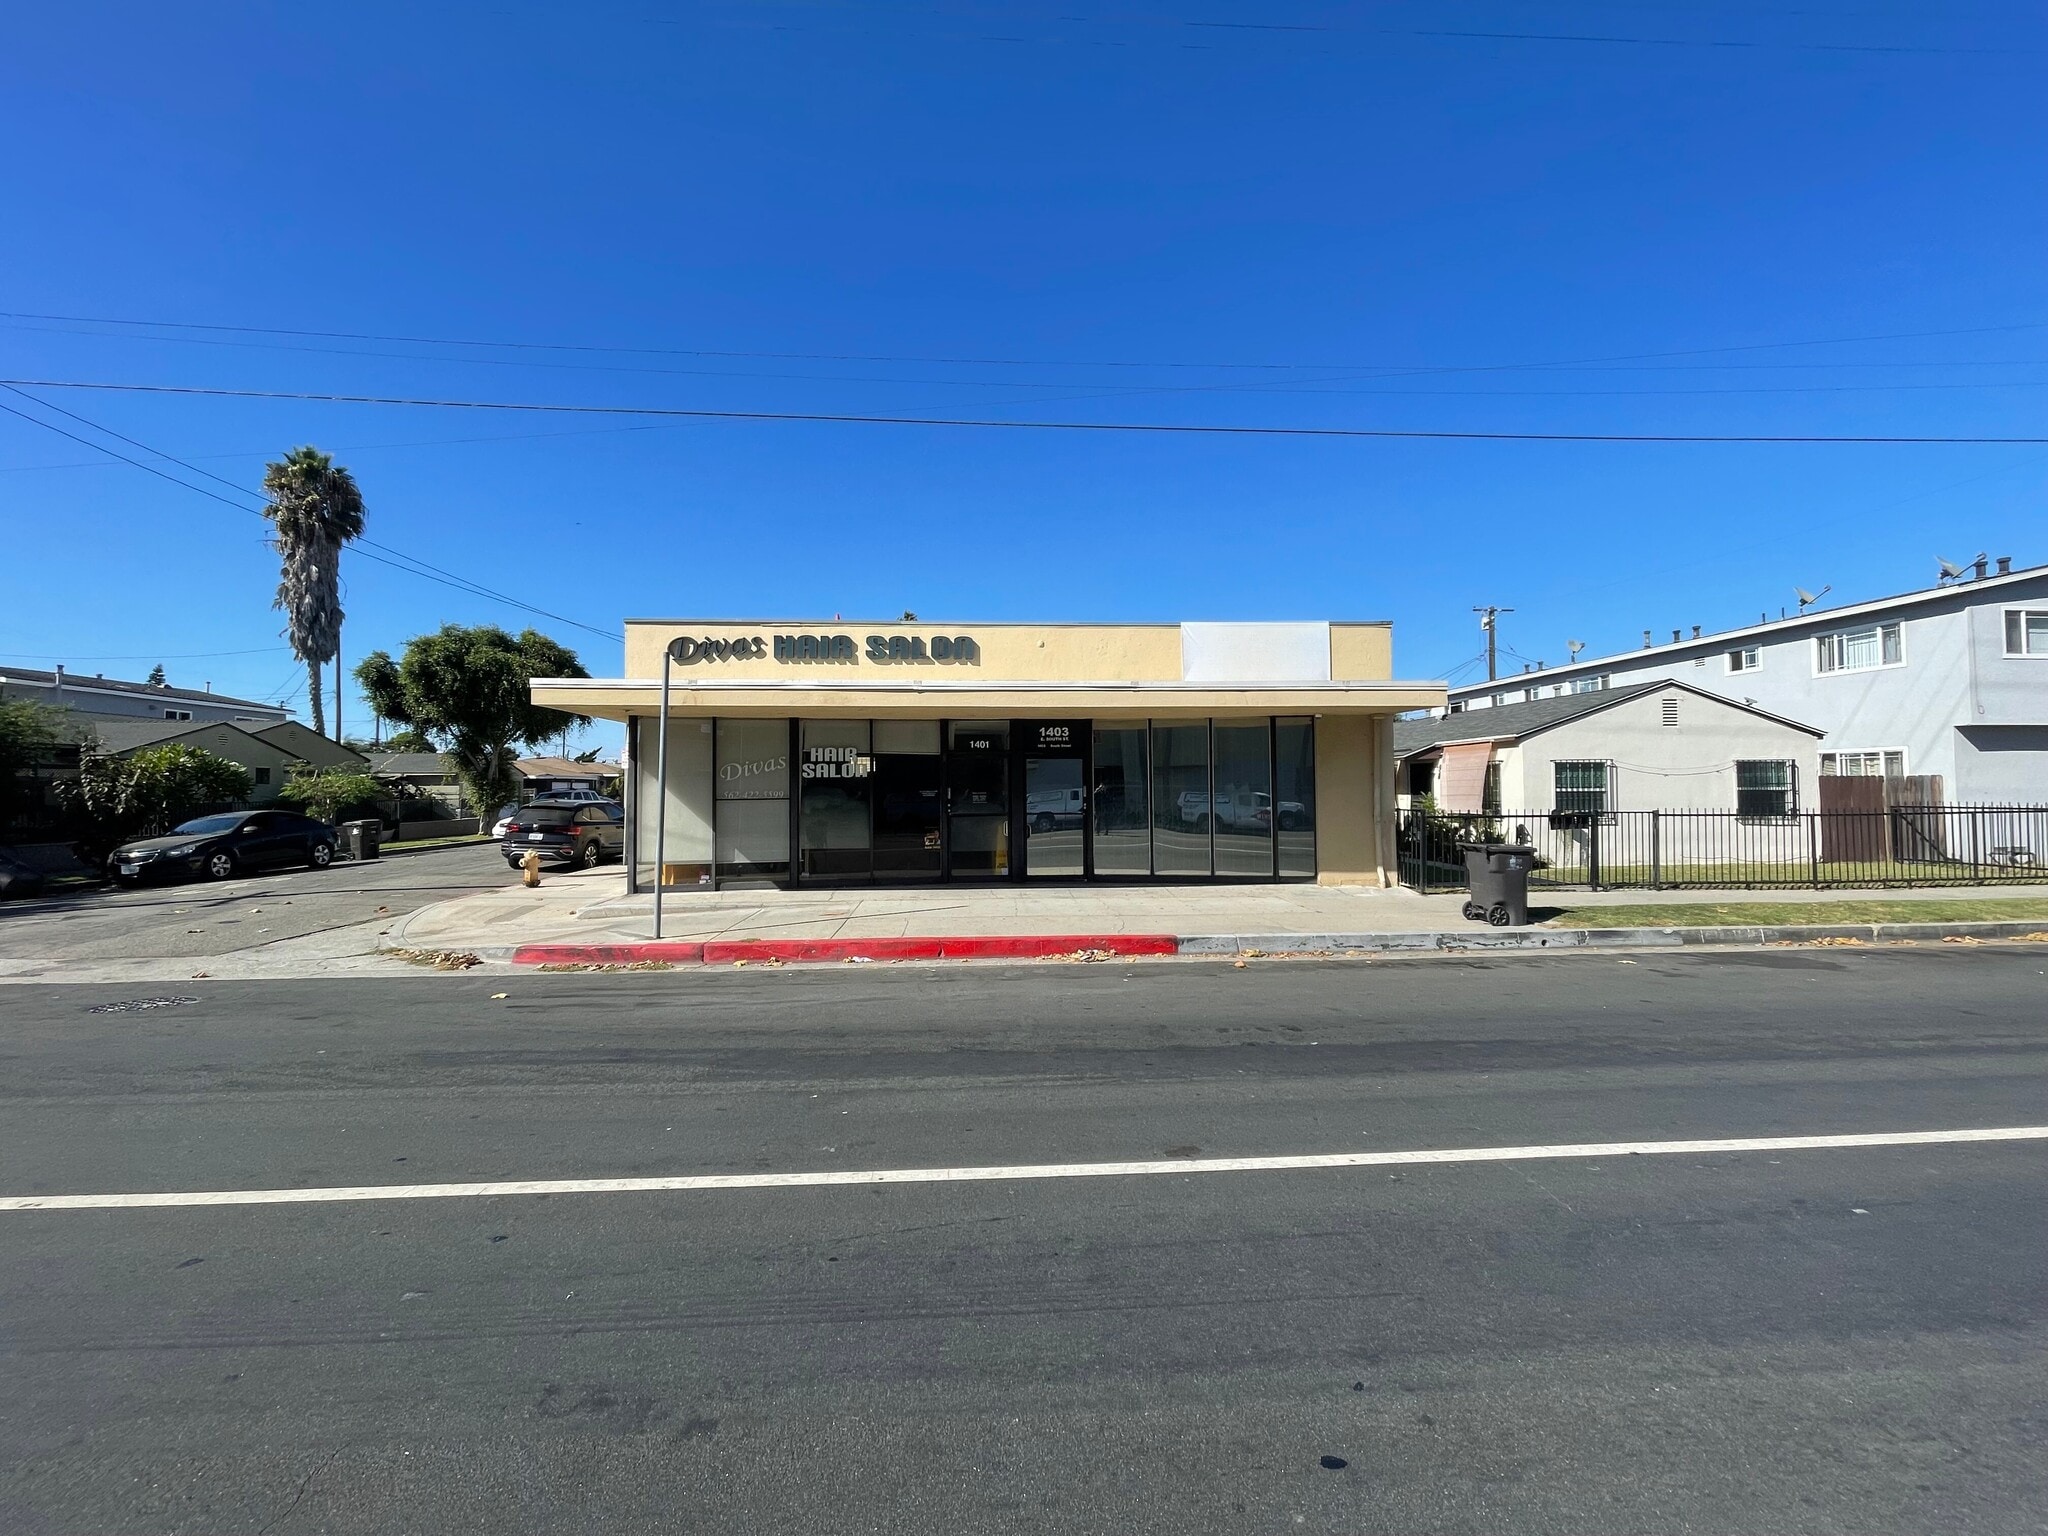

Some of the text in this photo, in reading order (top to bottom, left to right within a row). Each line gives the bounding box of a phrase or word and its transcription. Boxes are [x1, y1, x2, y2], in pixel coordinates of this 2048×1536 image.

[667, 635, 981, 666] Divas HAIR SALON
[1039, 727, 1069, 736] 1403
[969, 740, 990, 749] 1401
[810, 747, 858, 762] HAIR
[720, 756, 786, 781] Divas
[802, 763, 868, 778] SALON
